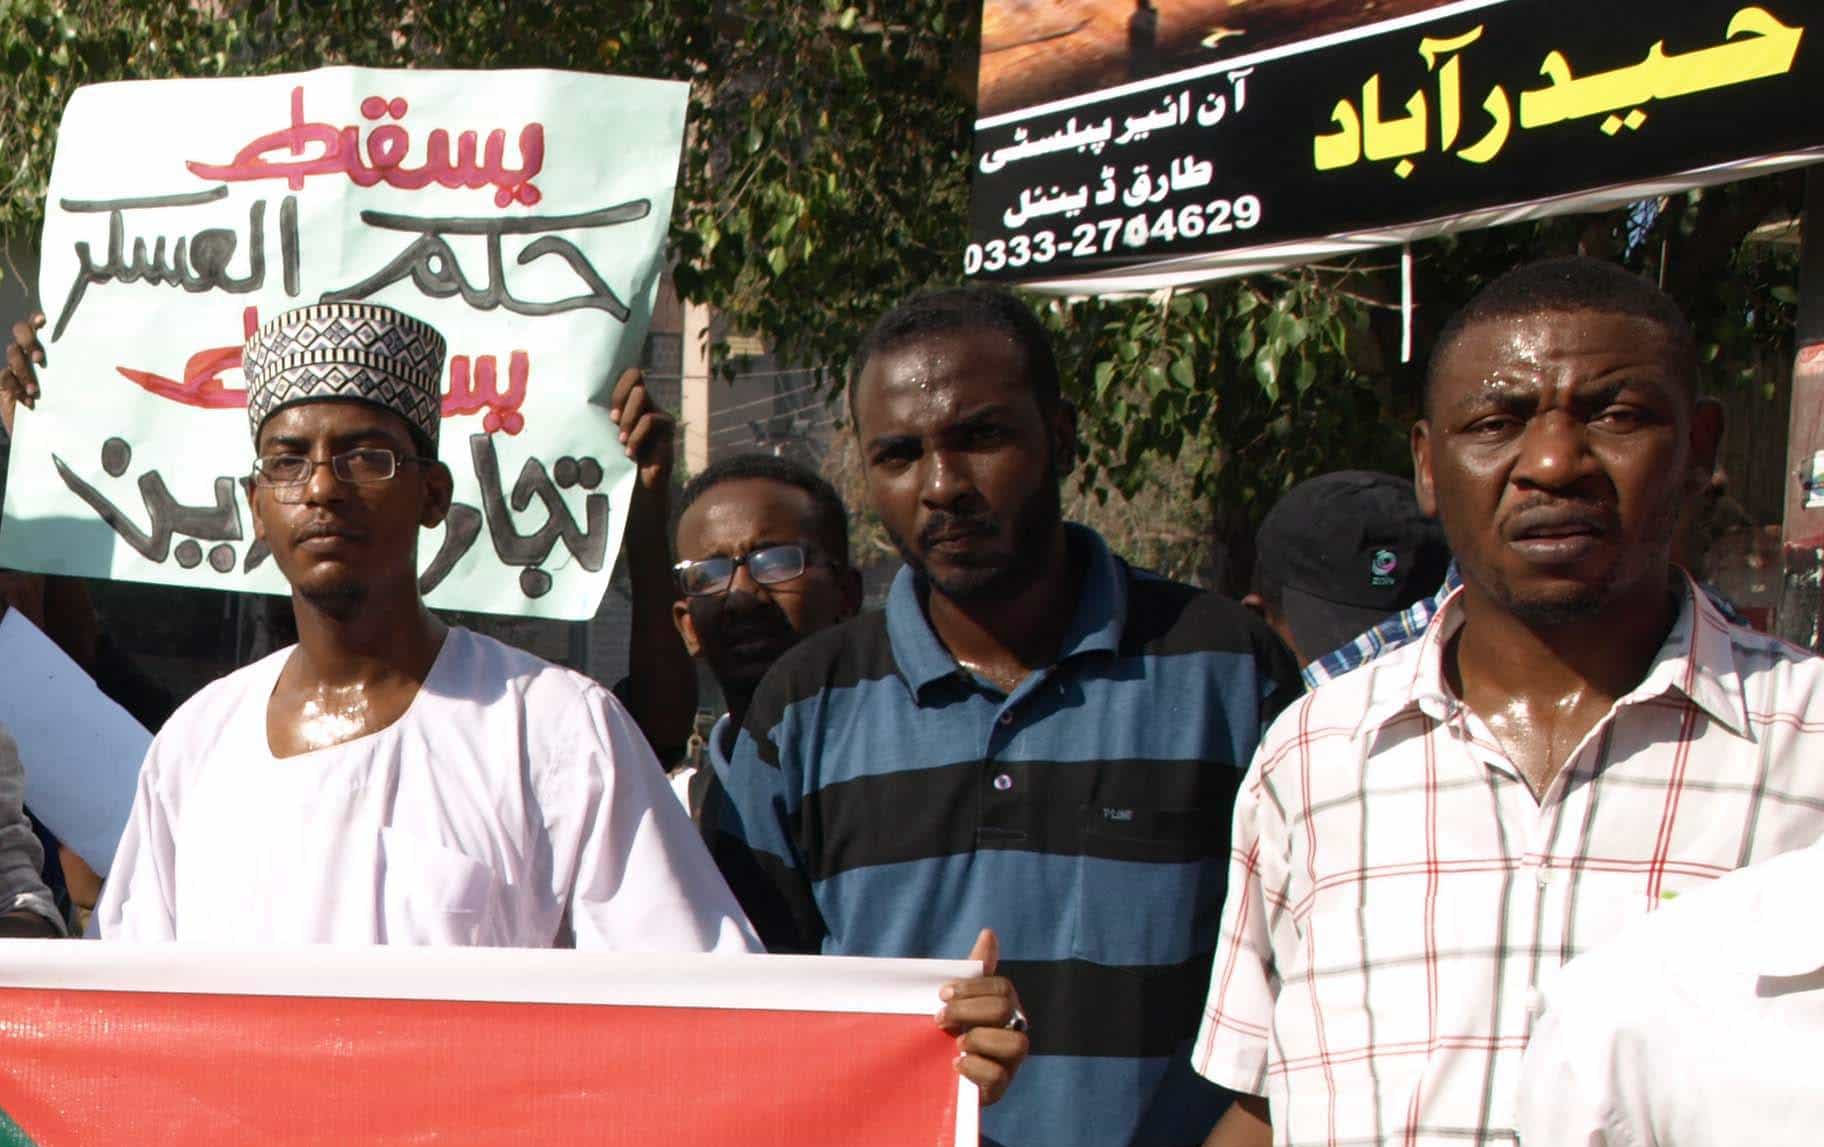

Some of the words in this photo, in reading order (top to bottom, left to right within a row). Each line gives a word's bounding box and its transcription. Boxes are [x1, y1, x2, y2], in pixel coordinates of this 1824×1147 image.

[186, 86, 545, 209] يسقط
[1122, 155, 1214, 208] طارق
[50, 185, 300, 344] العسكر
[319, 199, 651, 323] حكم
[115, 304, 530, 436] يسط
